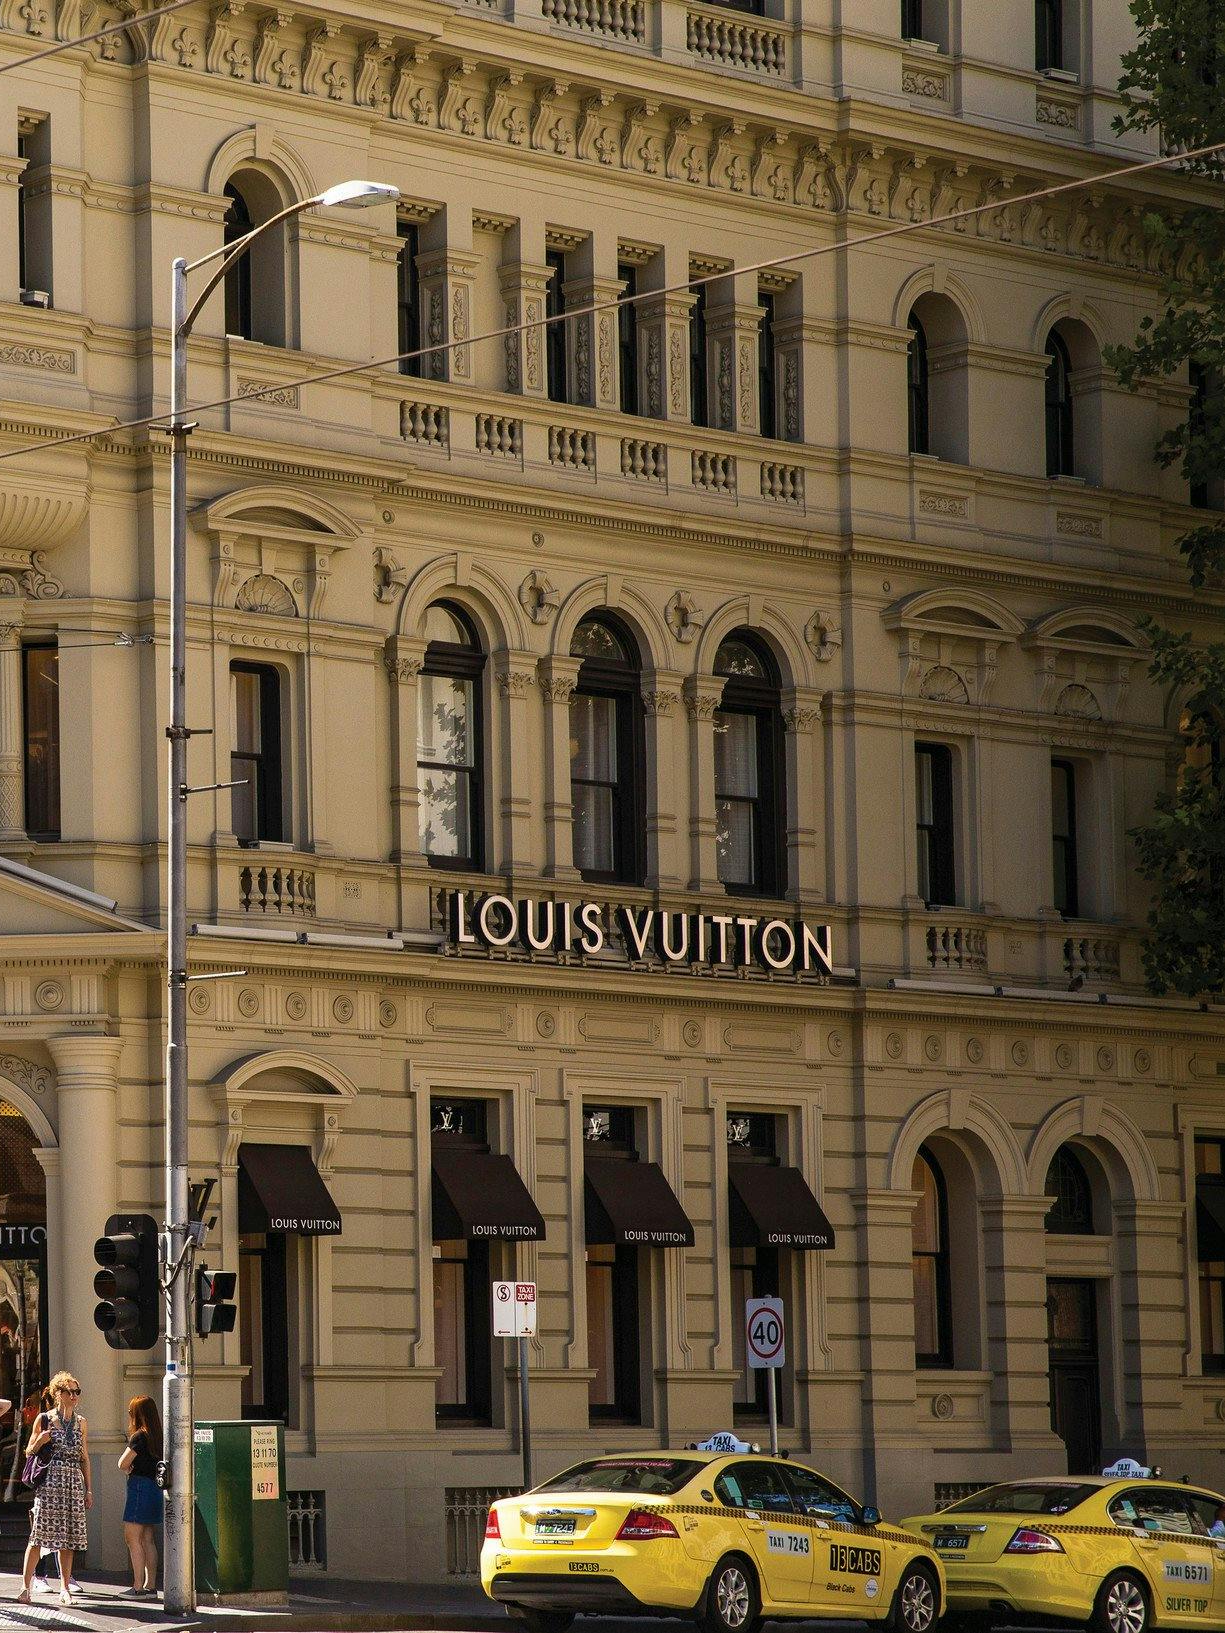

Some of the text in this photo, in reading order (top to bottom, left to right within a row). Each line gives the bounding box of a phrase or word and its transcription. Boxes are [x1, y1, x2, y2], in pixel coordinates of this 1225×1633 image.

[456, 892, 834, 974] LOUIS VUITTON
[271, 1218, 340, 1230] LOUIS VUITTON
[472, 1225, 537, 1236] LOUIS VUITTON
[624, 1230, 687, 1242] LOUIS VUITTON
[768, 1233, 827, 1245] LOUIS VUITTON
[752, 1321, 779, 1345] 40
[713, 1436, 731, 1445] TAXI
[253, 1448, 277, 1458] 13 11 70
[716, 1444, 735, 1452] CABS
[1117, 1463, 1130, 1471] TAXI
[257, 1482, 274, 1494] 4577
[552, 1524, 574, 1533] 7243
[769, 1536, 809, 1553] TAXI 7243
[947, 1539, 966, 1547] 6571
[1166, 1565, 1207, 1581] TAXI 6571
[826, 1582, 841, 1592] Black
[842, 1583, 856, 1594] Cabs
[1166, 1597, 1208, 1613] SILVER TOP
